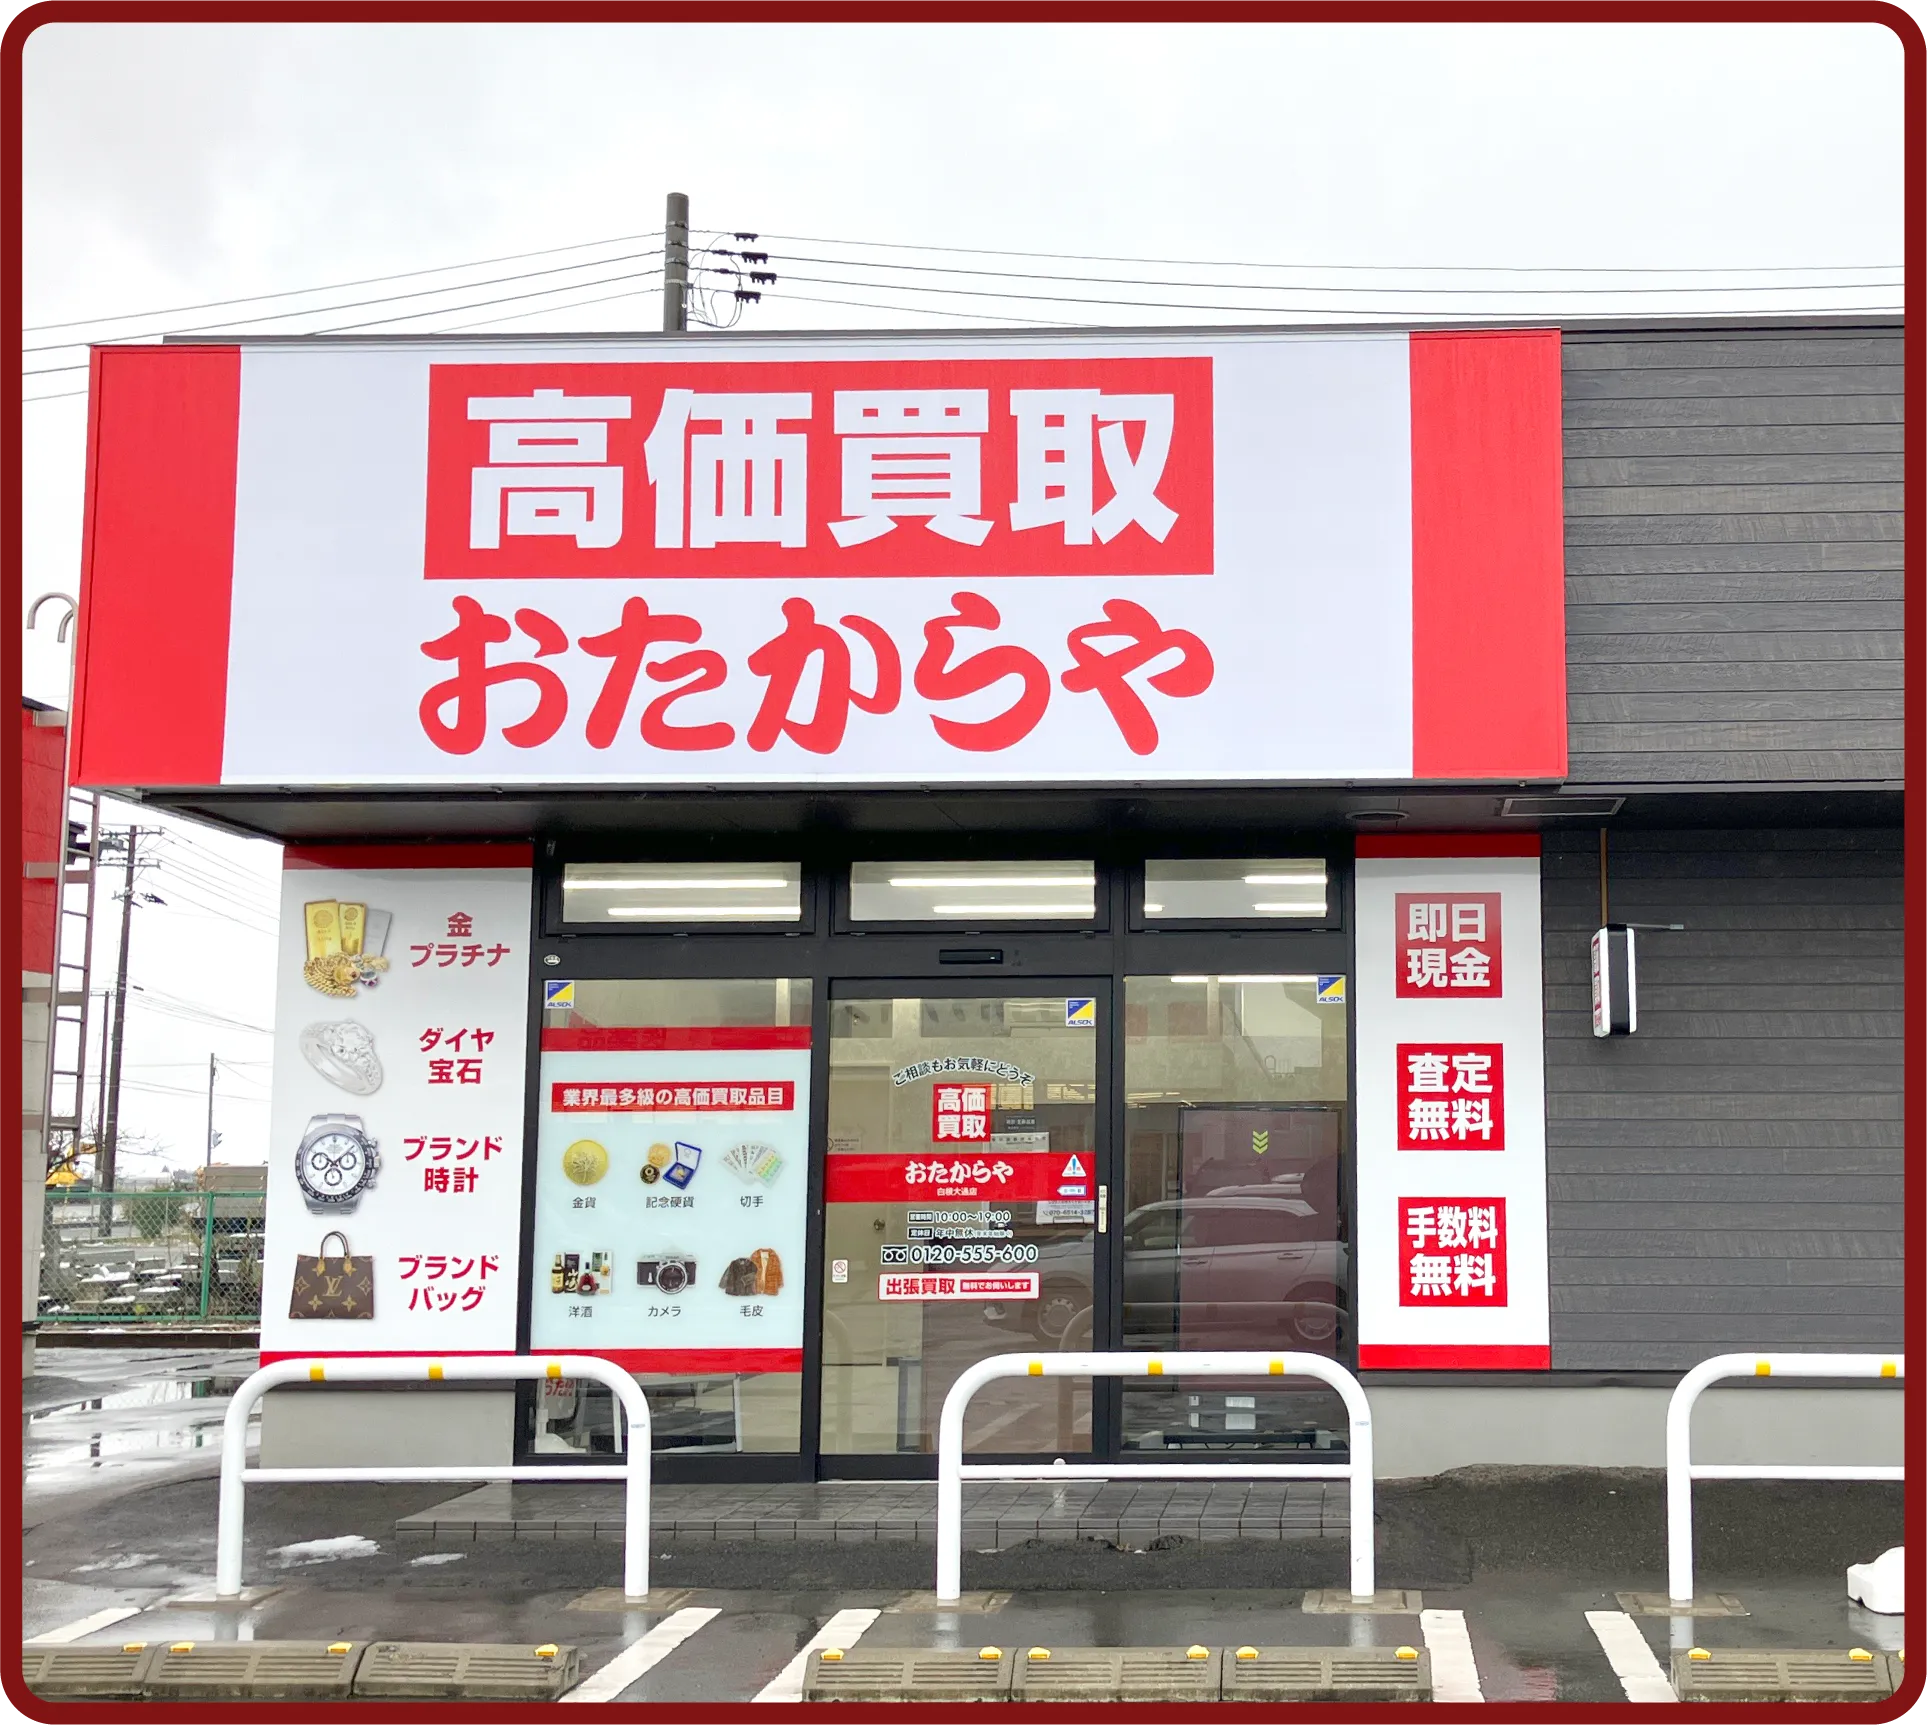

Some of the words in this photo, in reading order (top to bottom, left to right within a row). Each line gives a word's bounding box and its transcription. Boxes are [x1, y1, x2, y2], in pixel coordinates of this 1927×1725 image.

[467, 388, 1180, 550] 高価買取
[418, 591, 1215, 756] おたからや
[447, 911, 473, 937] 金
[1407, 902, 1487, 943] 即日
[409, 943, 511, 967] プラチナ
[1407, 947, 1491, 989] 現金
[418, 1027, 495, 1053] ダイヤ
[428, 1058, 483, 1085] 宝石
[893, 1057, 1034, 1087] ご相談もお気軽にどうぞ
[1407, 1052, 1493, 1094] 査定
[562, 1087, 784, 1107] 業界最多級の高価買取品目
[937, 1087, 987, 1113] 高価
[937, 1114, 987, 1139] 買取
[1408, 1098, 1493, 1140] 無料
[402, 1136, 503, 1160] ブランド
[424, 1167, 479, 1194] 時計
[905, 1160, 1014, 1184] おたからや
[572, 1196, 596, 1208] 金貨
[646, 1196, 694, 1208] 記念硬貨
[740, 1196, 763, 1207] 切手
[935, 1228, 974, 1238] 年中無休
[1406, 1206, 1498, 1249] 手数料
[911, 1246, 1038, 1263] 0120-555-600
[398, 1256, 499, 1280] ブランド
[1410, 1253, 1496, 1296] 無料
[886, 1278, 955, 1295] 出張買取
[408, 1287, 485, 1311] バッグ
[740, 1305, 763, 1317] 毛皮
[568, 1306, 593, 1318] 洋酒
[648, 1306, 681, 1318] カメラ
